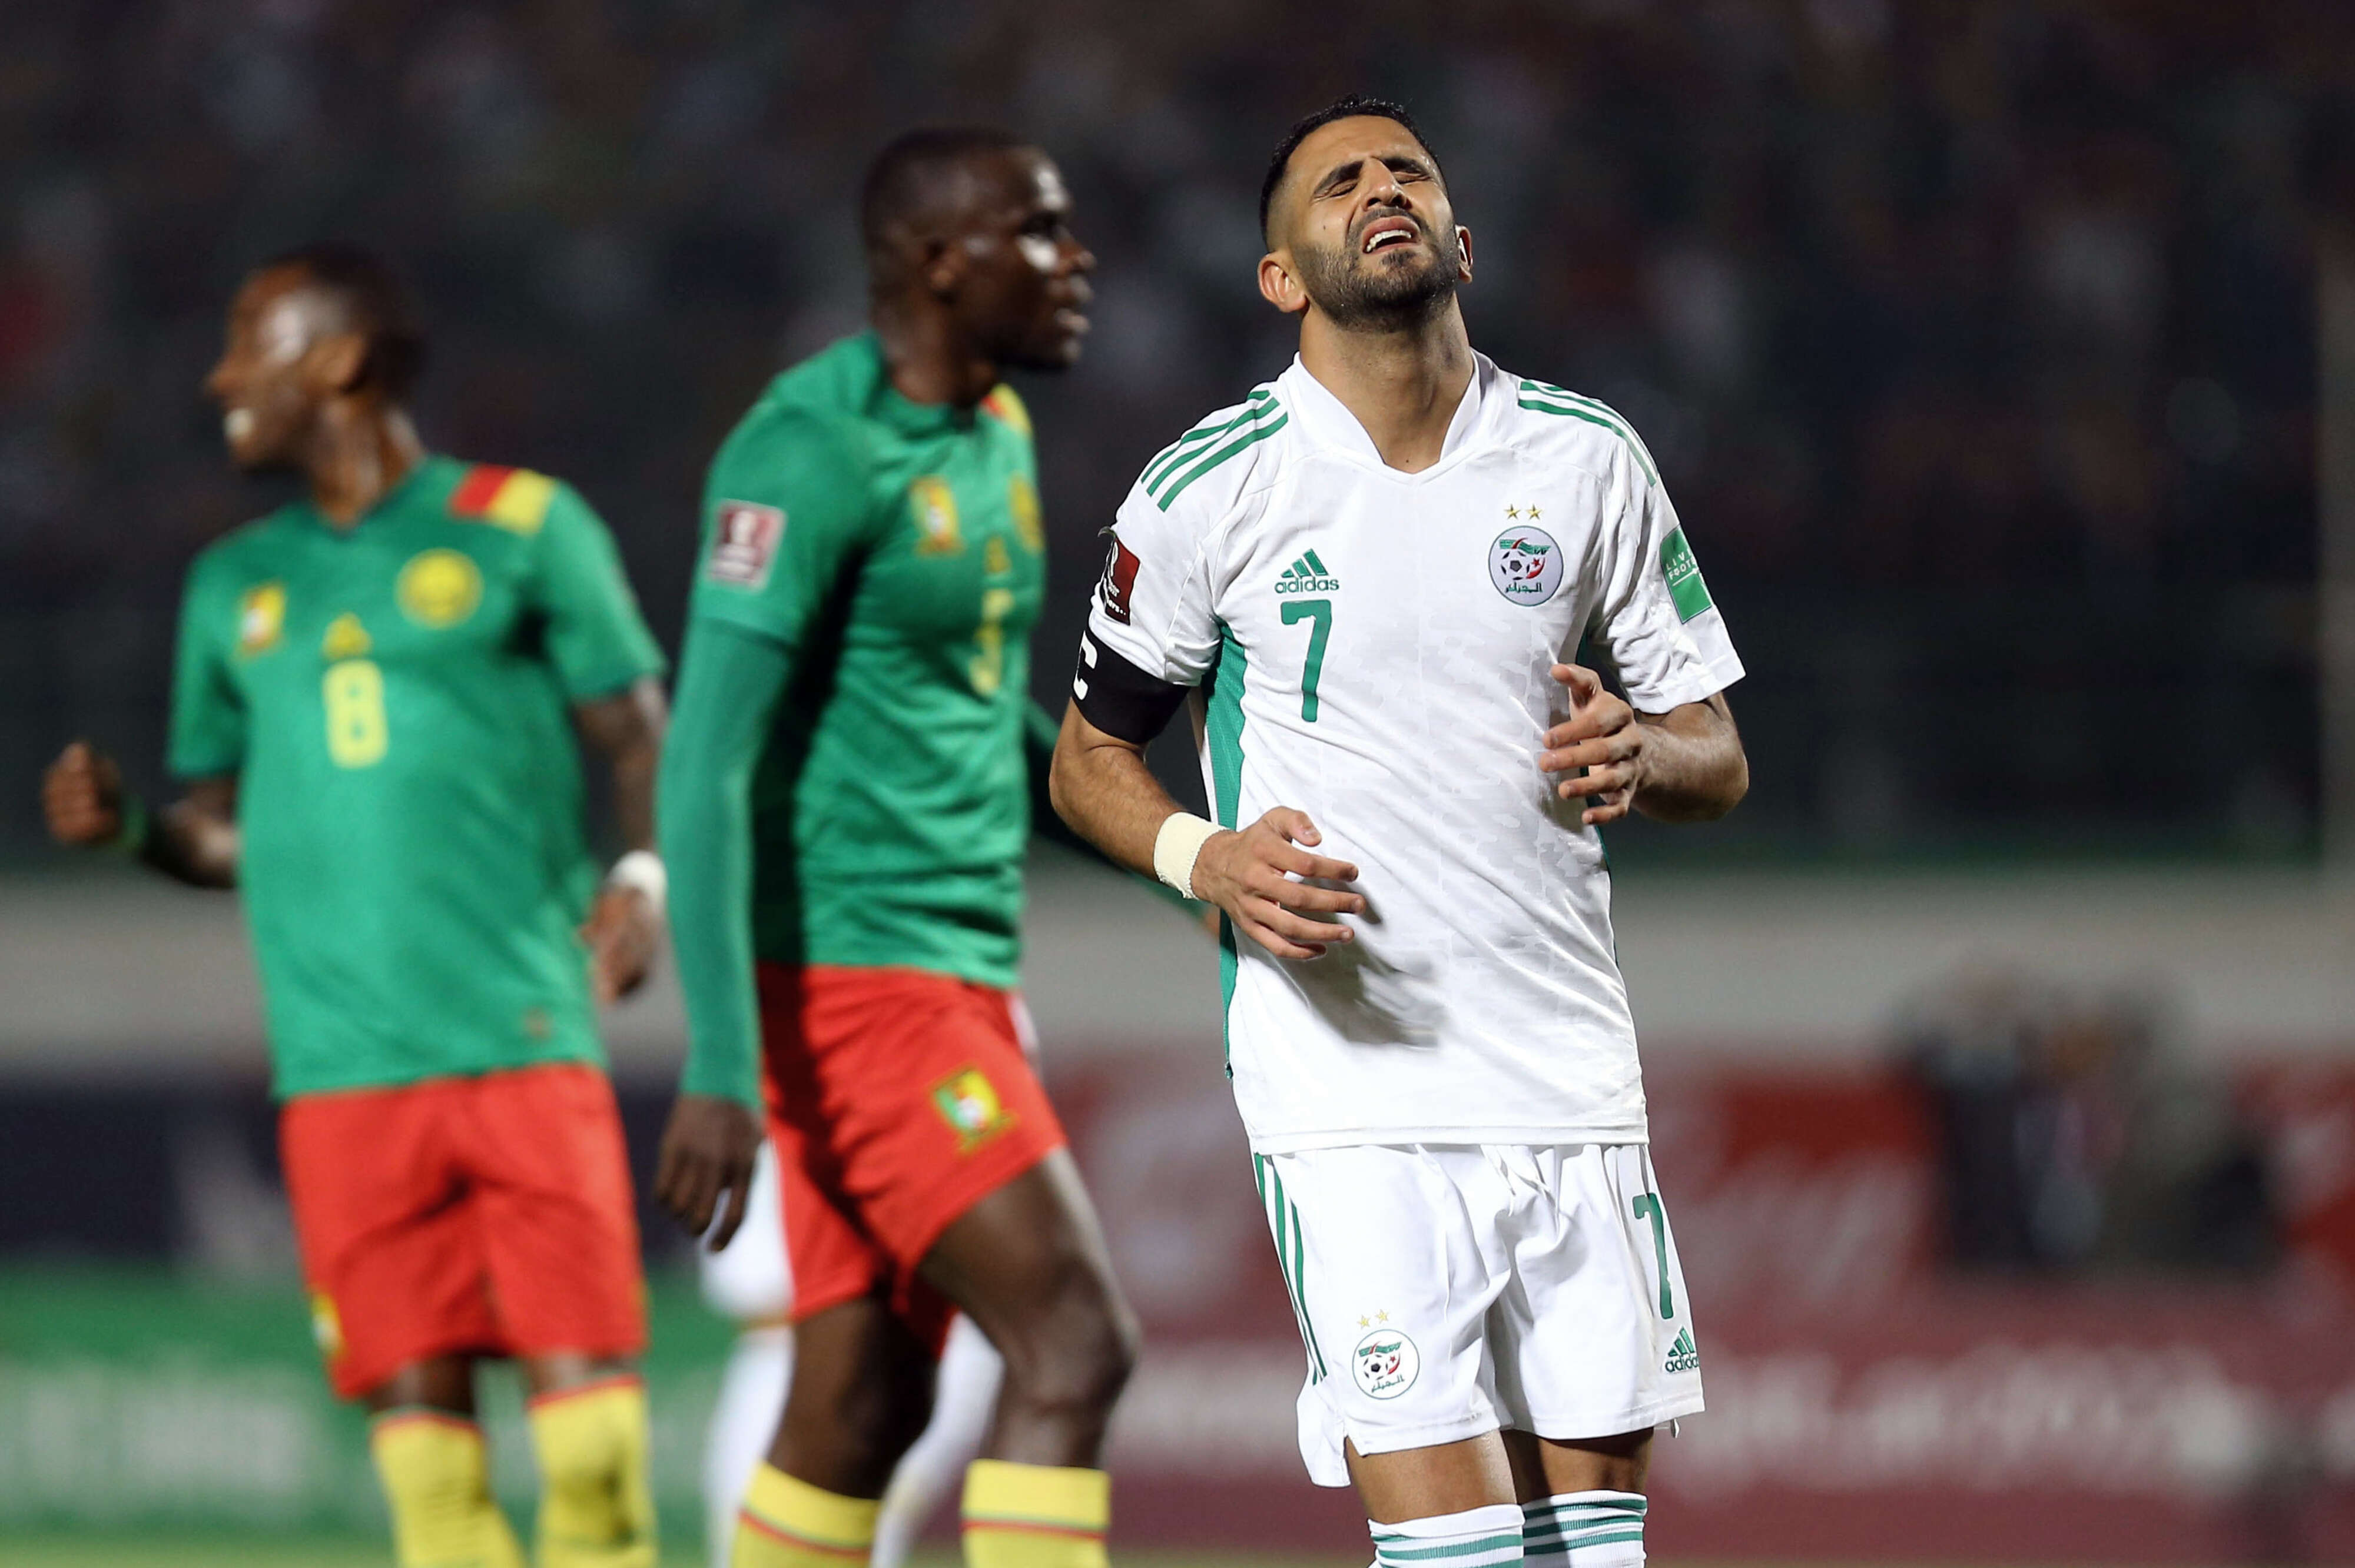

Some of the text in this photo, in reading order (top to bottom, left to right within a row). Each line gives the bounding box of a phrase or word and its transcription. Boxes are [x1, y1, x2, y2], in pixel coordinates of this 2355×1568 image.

[1274, 576, 1339, 594] adidas
[321, 658, 389, 769] 8
[1280, 599, 1332, 723] 7
[1632, 1192, 1674, 1320] 7
[1665, 1354, 1700, 1373] adida
